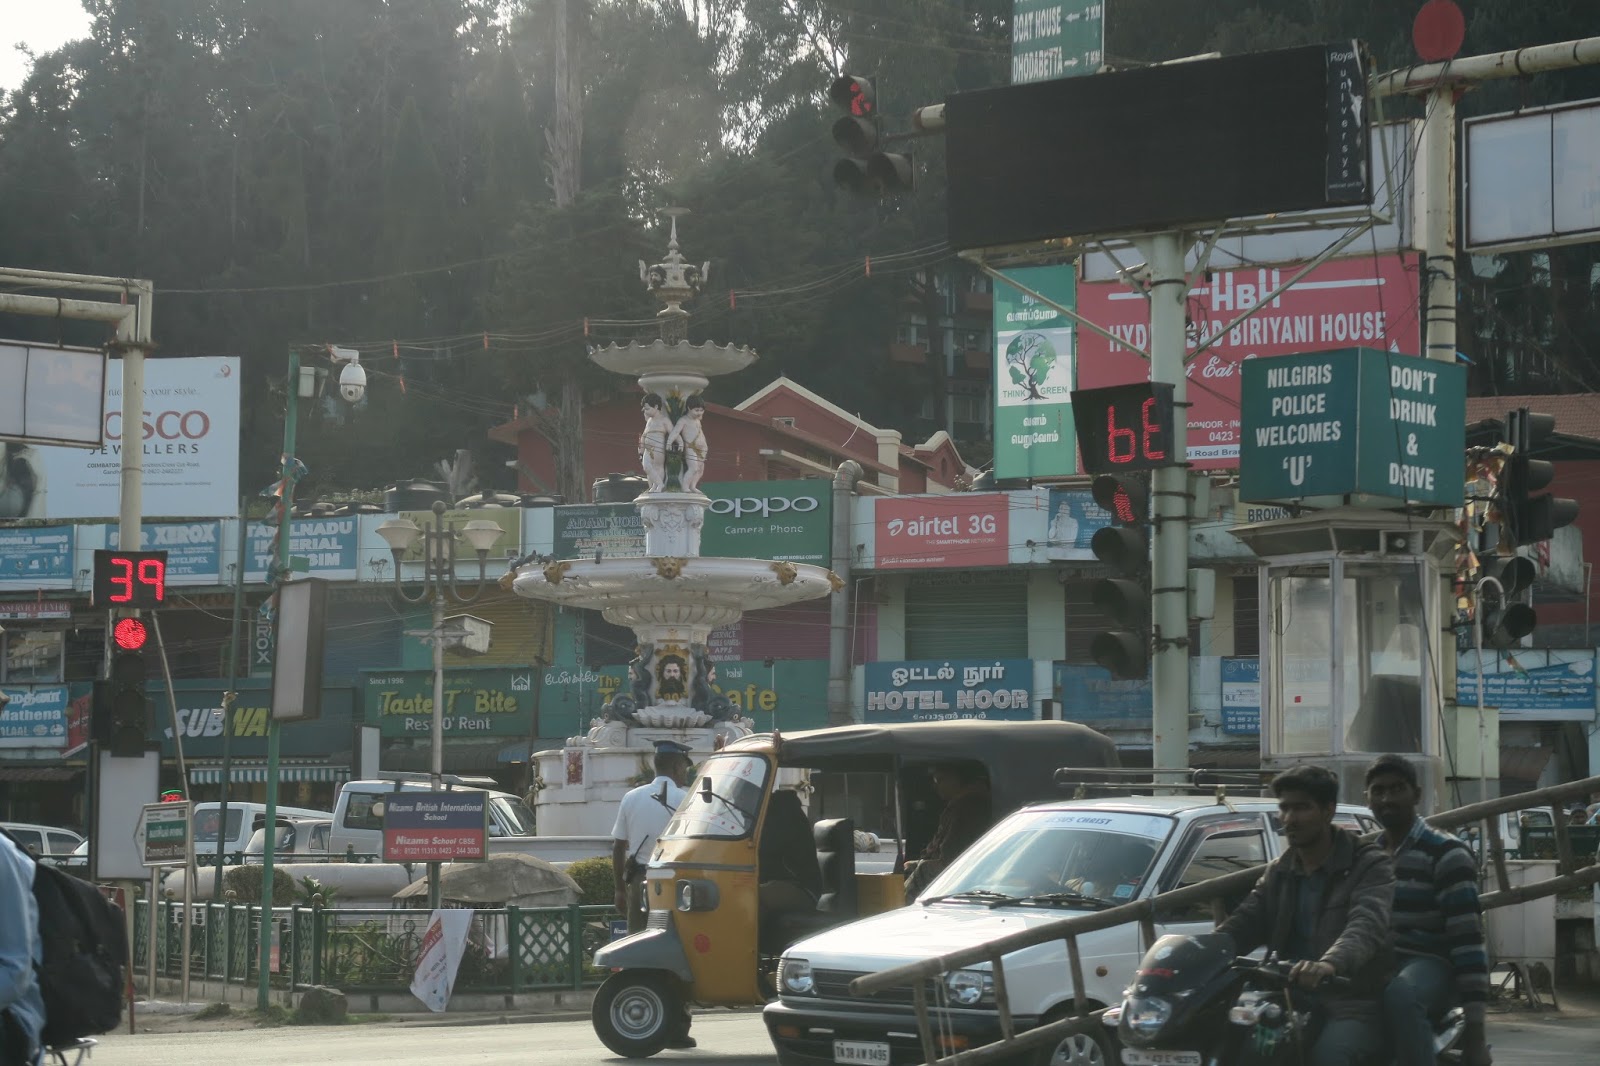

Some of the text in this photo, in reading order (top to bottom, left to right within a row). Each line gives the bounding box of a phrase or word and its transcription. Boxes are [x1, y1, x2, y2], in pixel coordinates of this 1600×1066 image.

[1013, 4, 1101, 43] BOAT HOUSE 3 KM
[1013, 46, 1063, 82] DHODABETTA
[1212, 268, 1281, 311] HBH
[1109, 311, 1386, 352] HYDBAD BIRIYANI HOUSE
[1267, 364, 1333, 388] NILGIRIS
[1390, 365, 1437, 394] DON'T
[150, 388, 170, 396] your
[1003, 386, 1068, 398] THINK GREEN
[1272, 393, 1326, 416] POLICE
[1389, 398, 1437, 427] DRINK
[105, 410, 210, 441] OSCO
[1186, 420, 1223, 429] OONOOR
[1256, 420, 1342, 447] WELCOMES
[1209, 431, 1233, 441] 0423
[1406, 433, 1418, 455] &
[89, 444, 199, 455] JEWLLERS
[1389, 463, 1435, 491] DRIVE
[567, 518, 608, 529] ADAM
[907, 514, 996, 536] airtel 3G
[1247, 507, 1291, 522] BROWS
[153, 523, 216, 545] XEROX
[246, 521, 353, 538] TAMLNADU
[724, 524, 804, 535] Camera Phone
[253, 537, 343, 553] IMERIAL
[110, 558, 165, 602] 39
[256, 613, 271, 663] EROX
[712, 631, 737, 639] SERVICE
[369, 677, 404, 685] Since 1996
[511, 677, 531, 691] halal
[598, 675, 621, 687] The
[380, 690, 433, 715] Taste
[475, 689, 517, 714] Bite
[712, 684, 777, 711] afe
[867, 689, 1029, 711] HOTEL NOOR
[164, 707, 271, 739] SUBWA
[459, 716, 491, 730] Rent
[415, 802, 437, 812] British
[440, 801, 482, 812] International
[424, 813, 447, 821] School
[1076, 817, 1112, 825] CHRIST
[395, 835, 429, 845] Nizams
[432, 836, 456, 845] School
